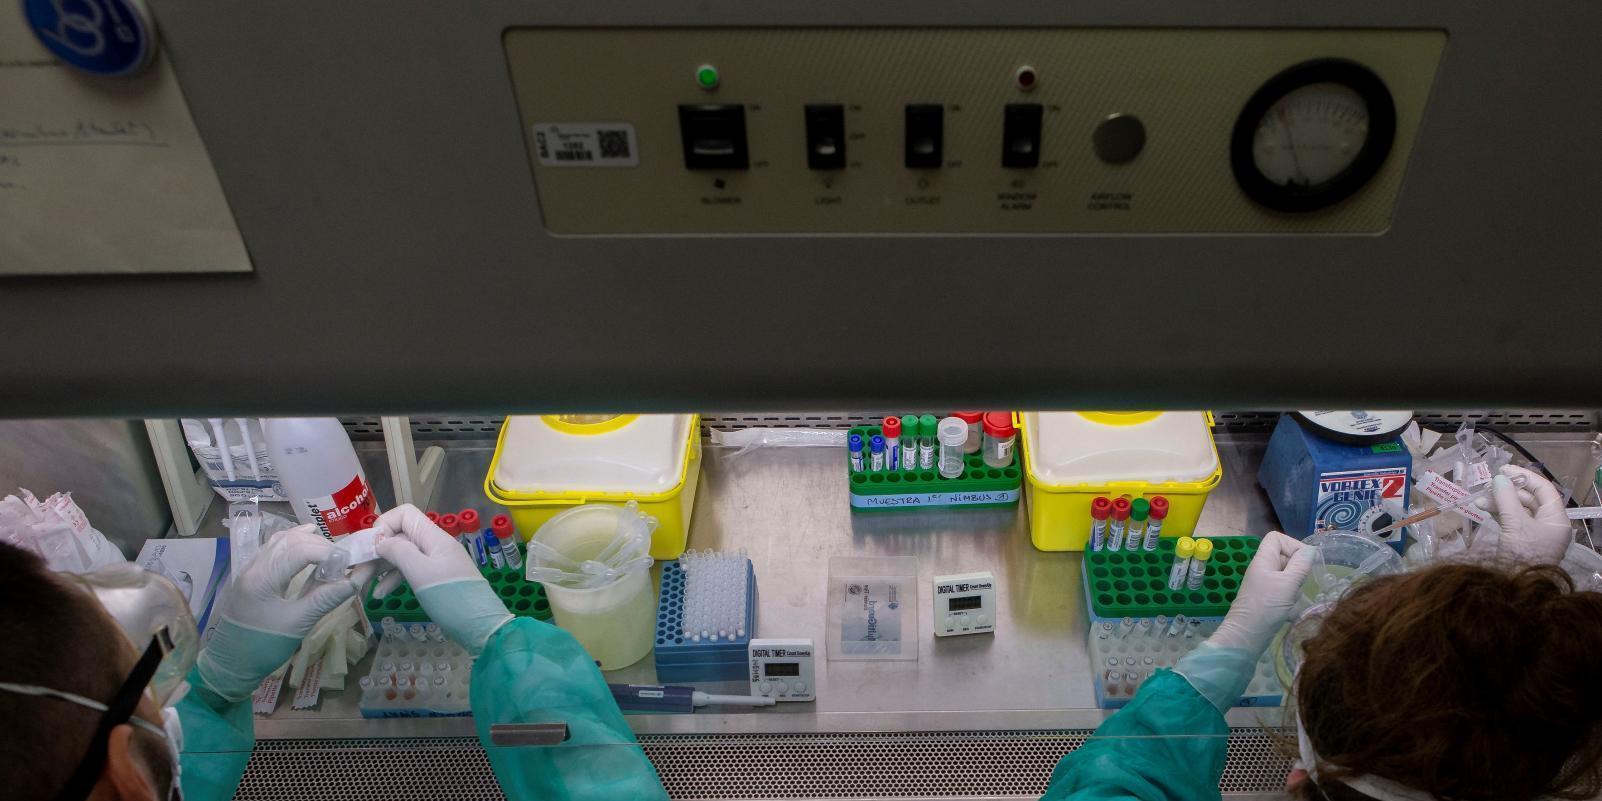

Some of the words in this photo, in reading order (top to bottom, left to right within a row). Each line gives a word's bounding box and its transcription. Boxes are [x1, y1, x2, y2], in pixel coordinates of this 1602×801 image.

[815, 196, 842, 205] LIGHT
[1321, 478, 1382, 492] VORTEX
[1382, 476, 1405, 498] 2
[327, 482, 369, 519] alcohol
[937, 585, 956, 594] DIGITAL
[955, 584, 970, 593] TIMER
